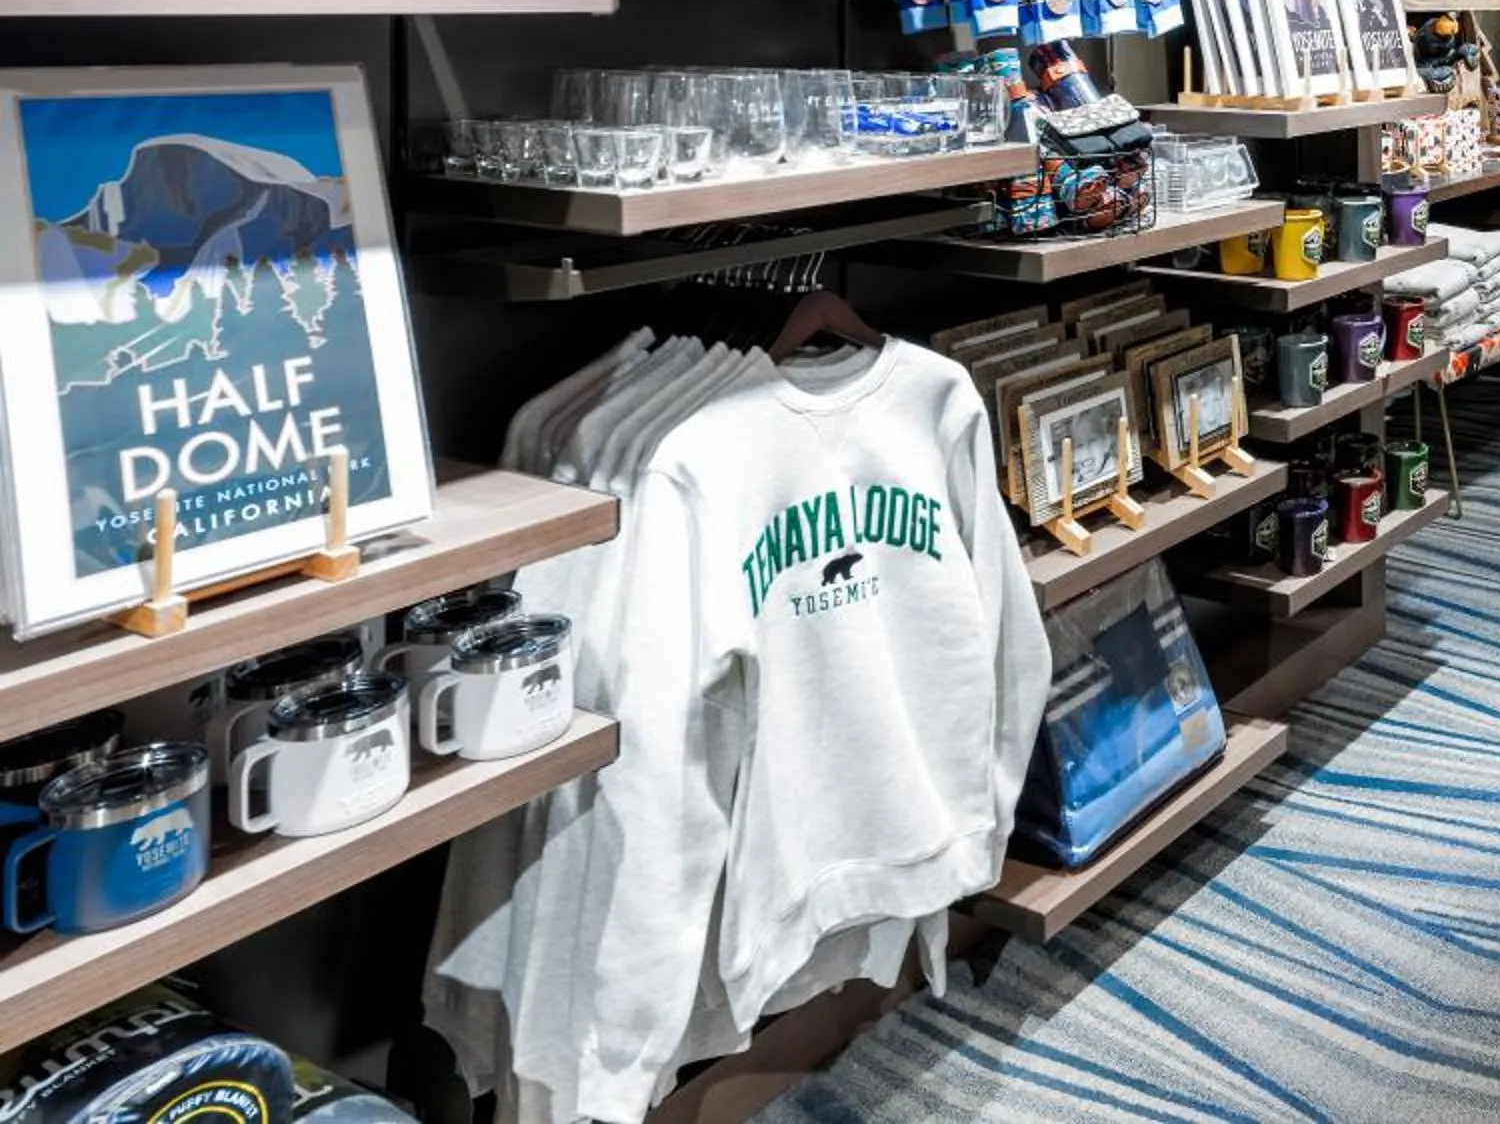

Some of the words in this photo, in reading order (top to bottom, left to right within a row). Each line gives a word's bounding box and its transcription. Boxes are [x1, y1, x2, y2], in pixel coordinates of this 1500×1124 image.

[138, 355, 315, 436] HALF
[119, 406, 342, 503] DOME
[95, 494, 205, 533] YOSEITE
[216, 467, 318, 503] NATIONAL
[742, 491, 845, 619] TENAYA
[849, 484, 942, 562] LODGE
